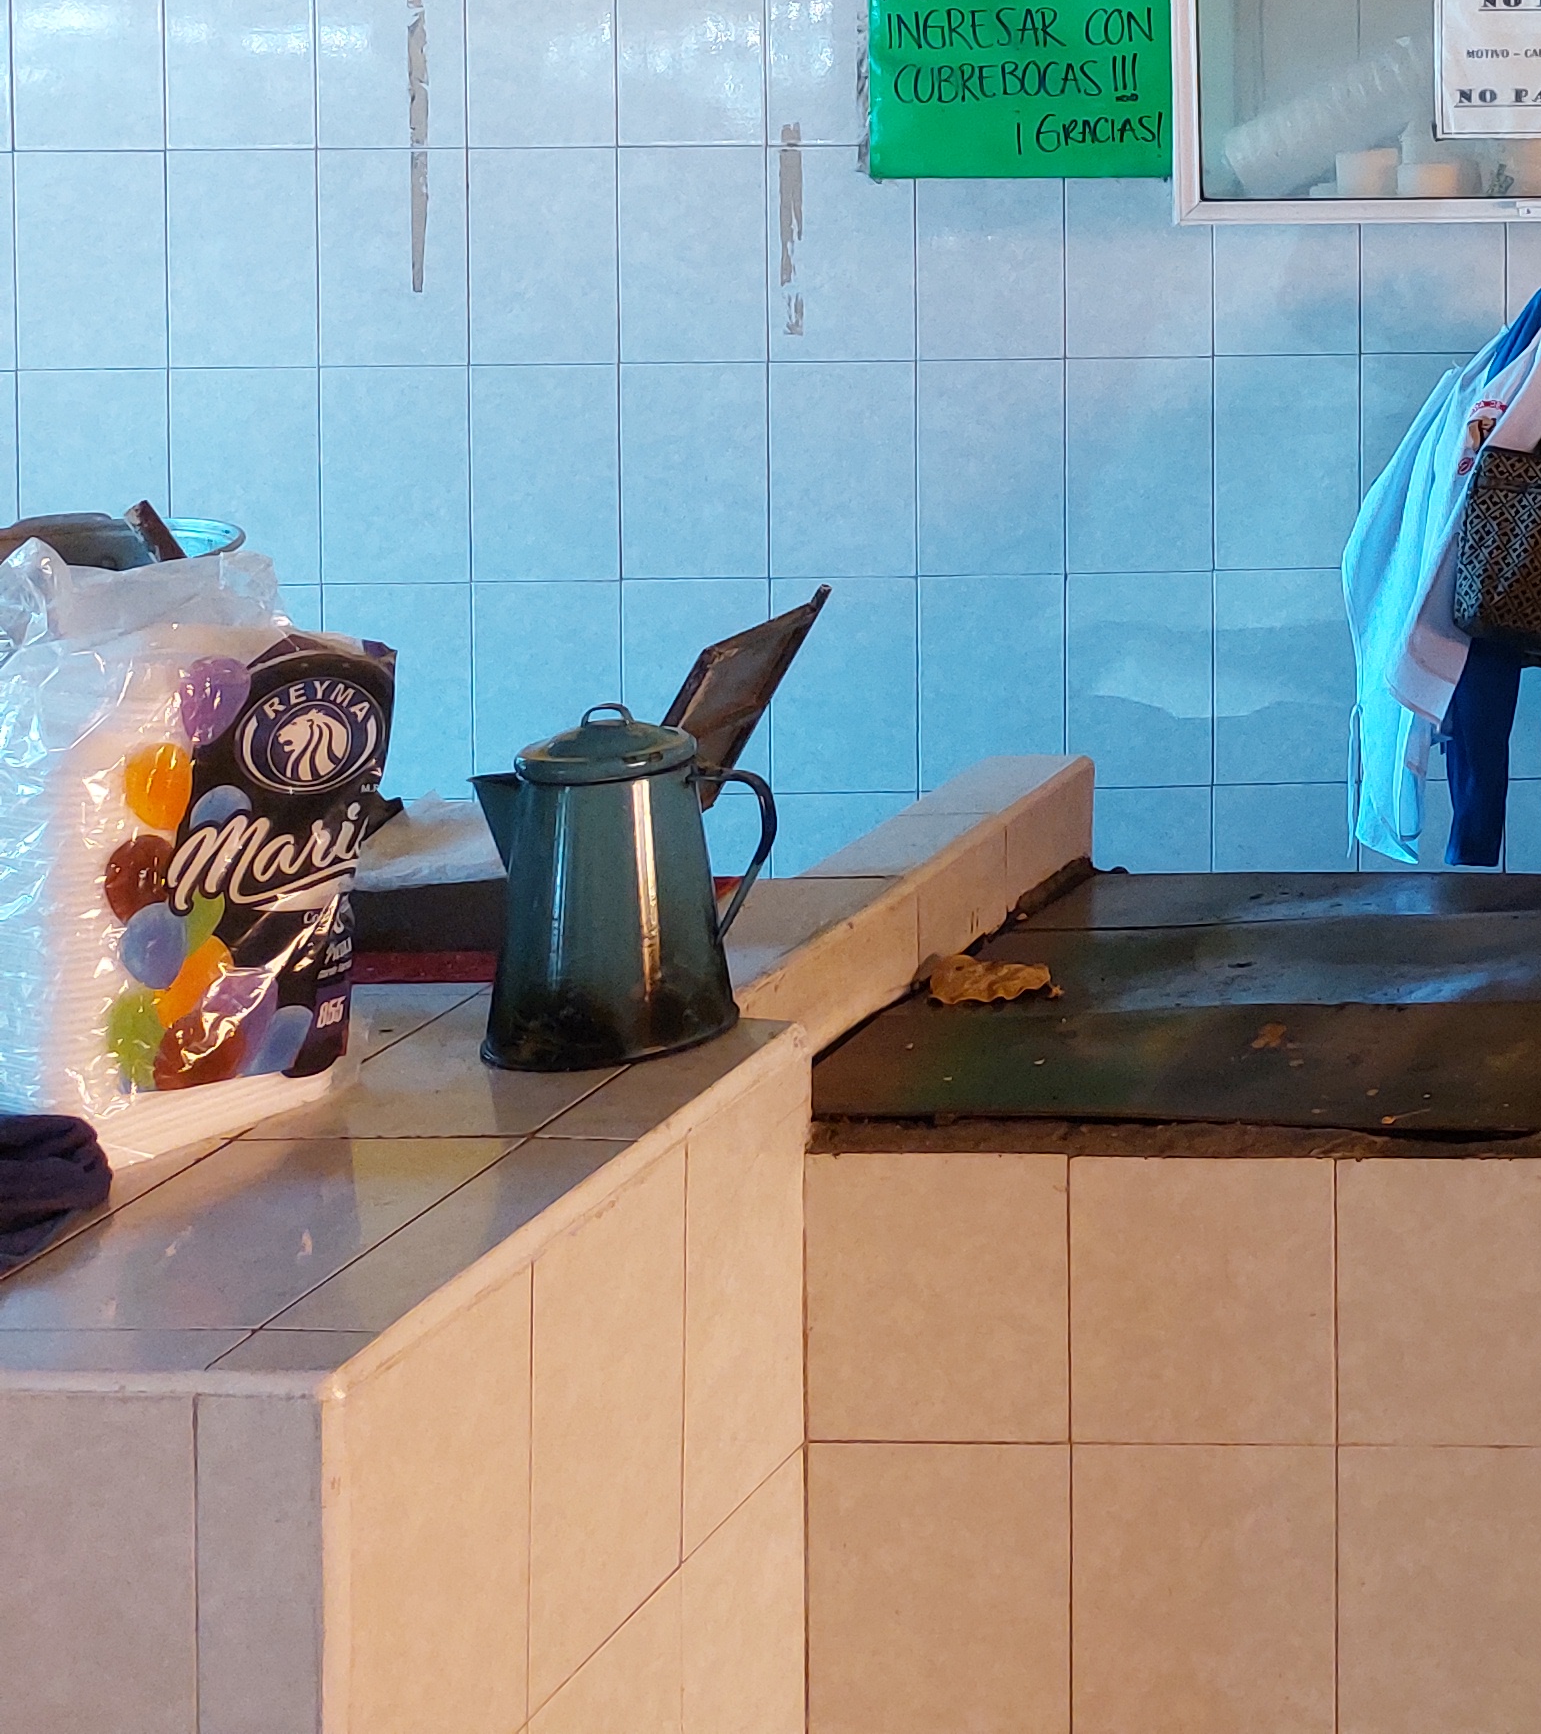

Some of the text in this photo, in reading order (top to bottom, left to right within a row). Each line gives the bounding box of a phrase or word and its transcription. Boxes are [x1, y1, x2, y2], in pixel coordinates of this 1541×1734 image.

[887, 6, 1154, 50] INGRESAR CON
[1467, 49, 1509, 58] MOTIVO
[1456, 89, 1497, 103] NO
[262, 680, 371, 722] REYMA
